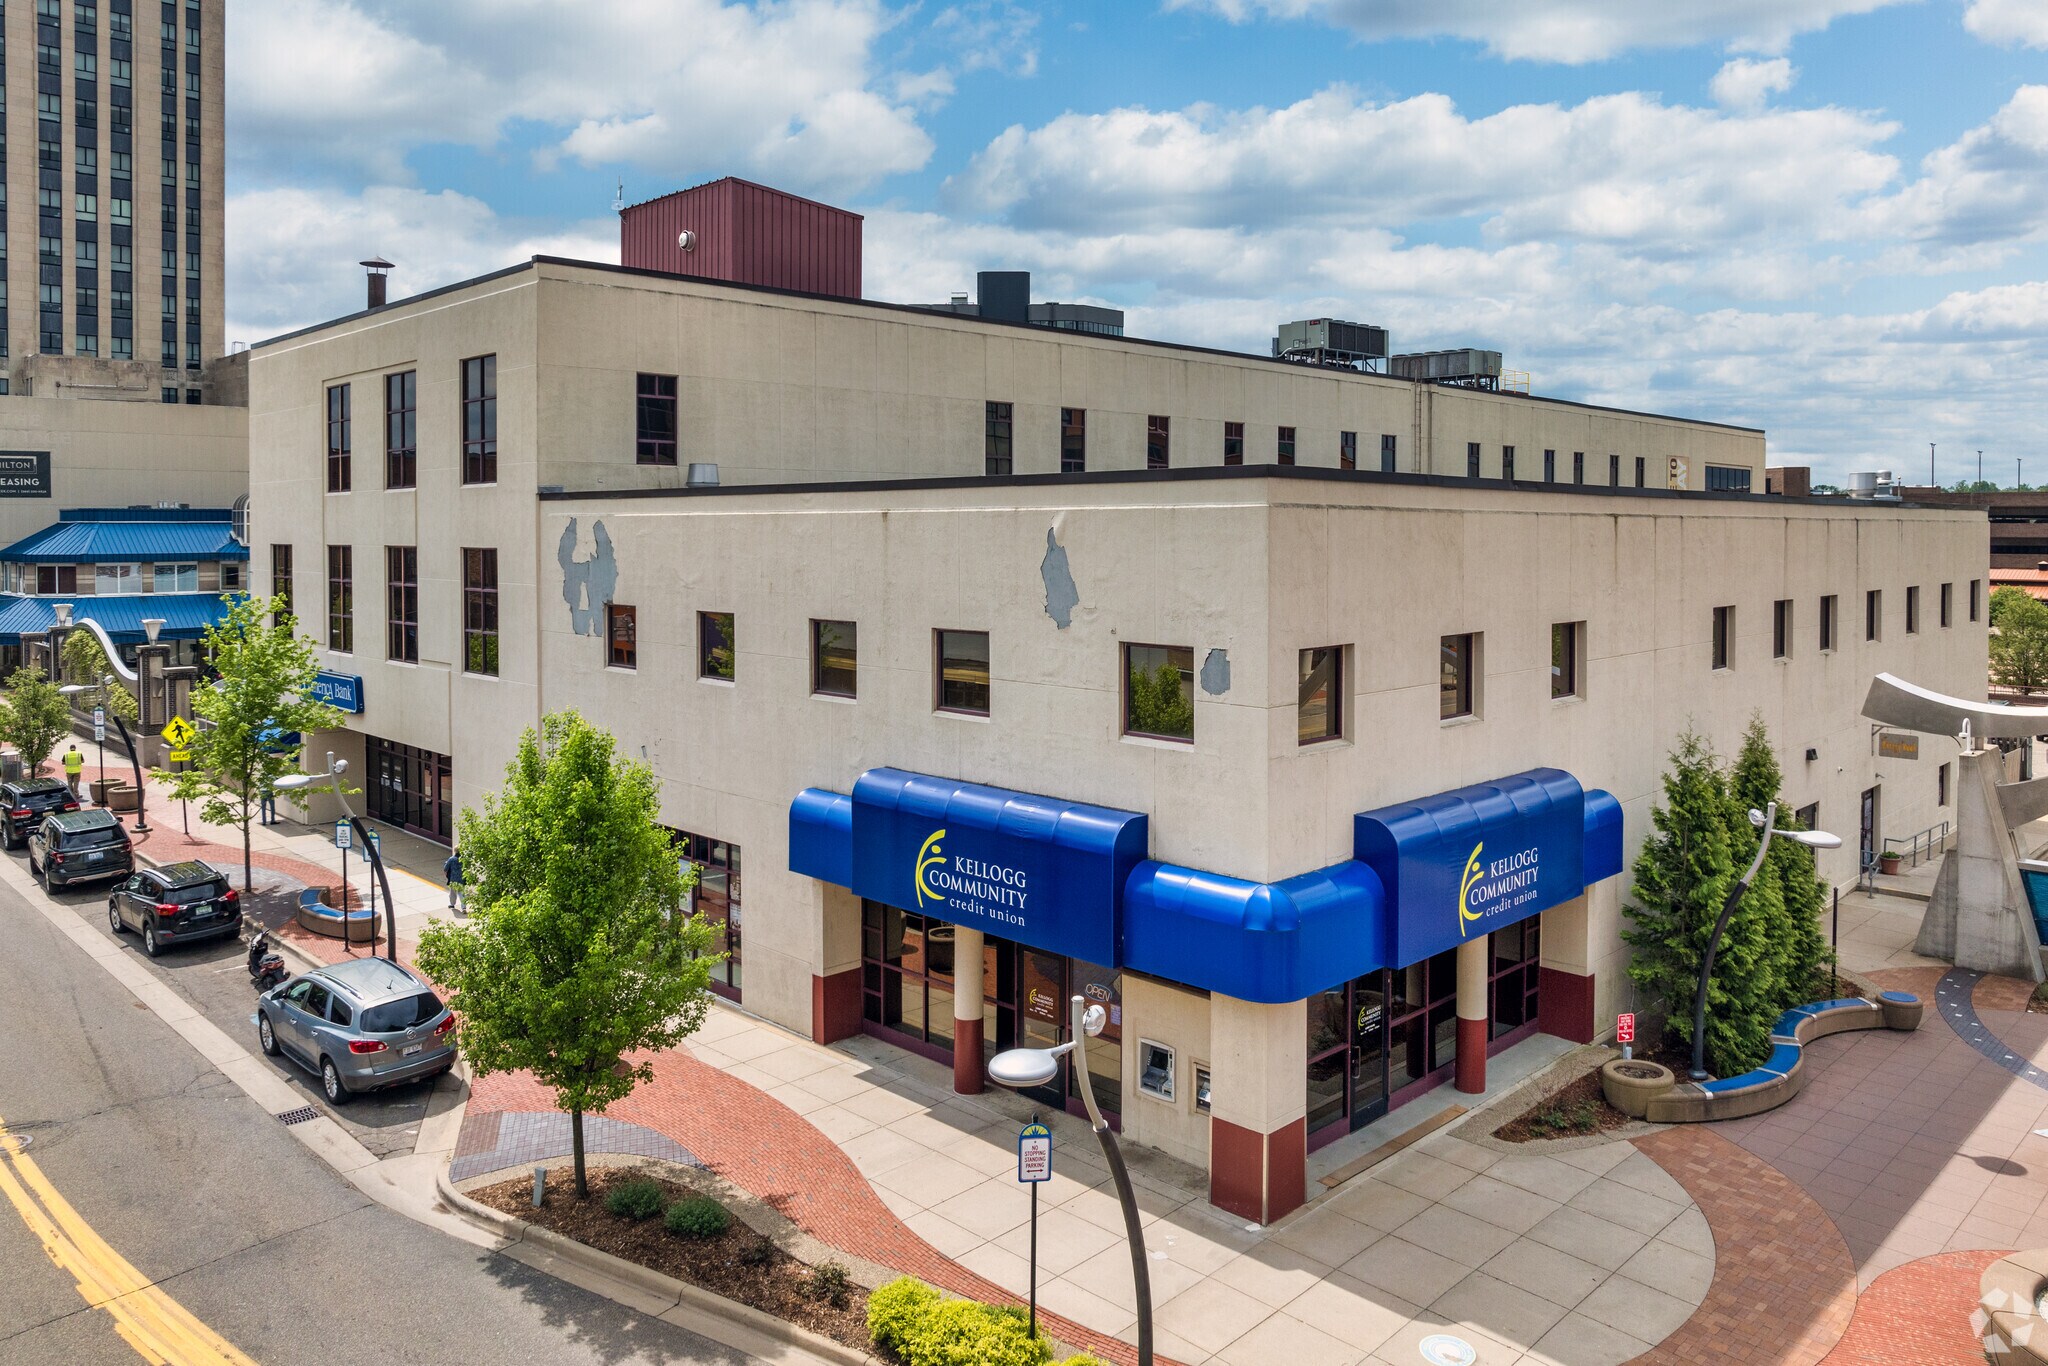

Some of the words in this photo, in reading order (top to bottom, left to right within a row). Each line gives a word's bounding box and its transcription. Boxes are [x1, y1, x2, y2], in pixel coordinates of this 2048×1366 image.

[0, 461, 31, 469] ILTON
[334, 683, 352, 701] Bank
[955, 856, 1026, 888] KELLOGG
[1490, 847, 1539, 878] KELLOGG
[929, 869, 1027, 909] COMMUNITY
[1470, 866, 1539, 906] COMMUNITY
[949, 898, 985, 915] credit
[989, 907, 1026, 927] union
[1486, 898, 1511, 917] credit
[1514, 890, 1538, 906] union
[1085, 983, 1111, 1002] OPEN
